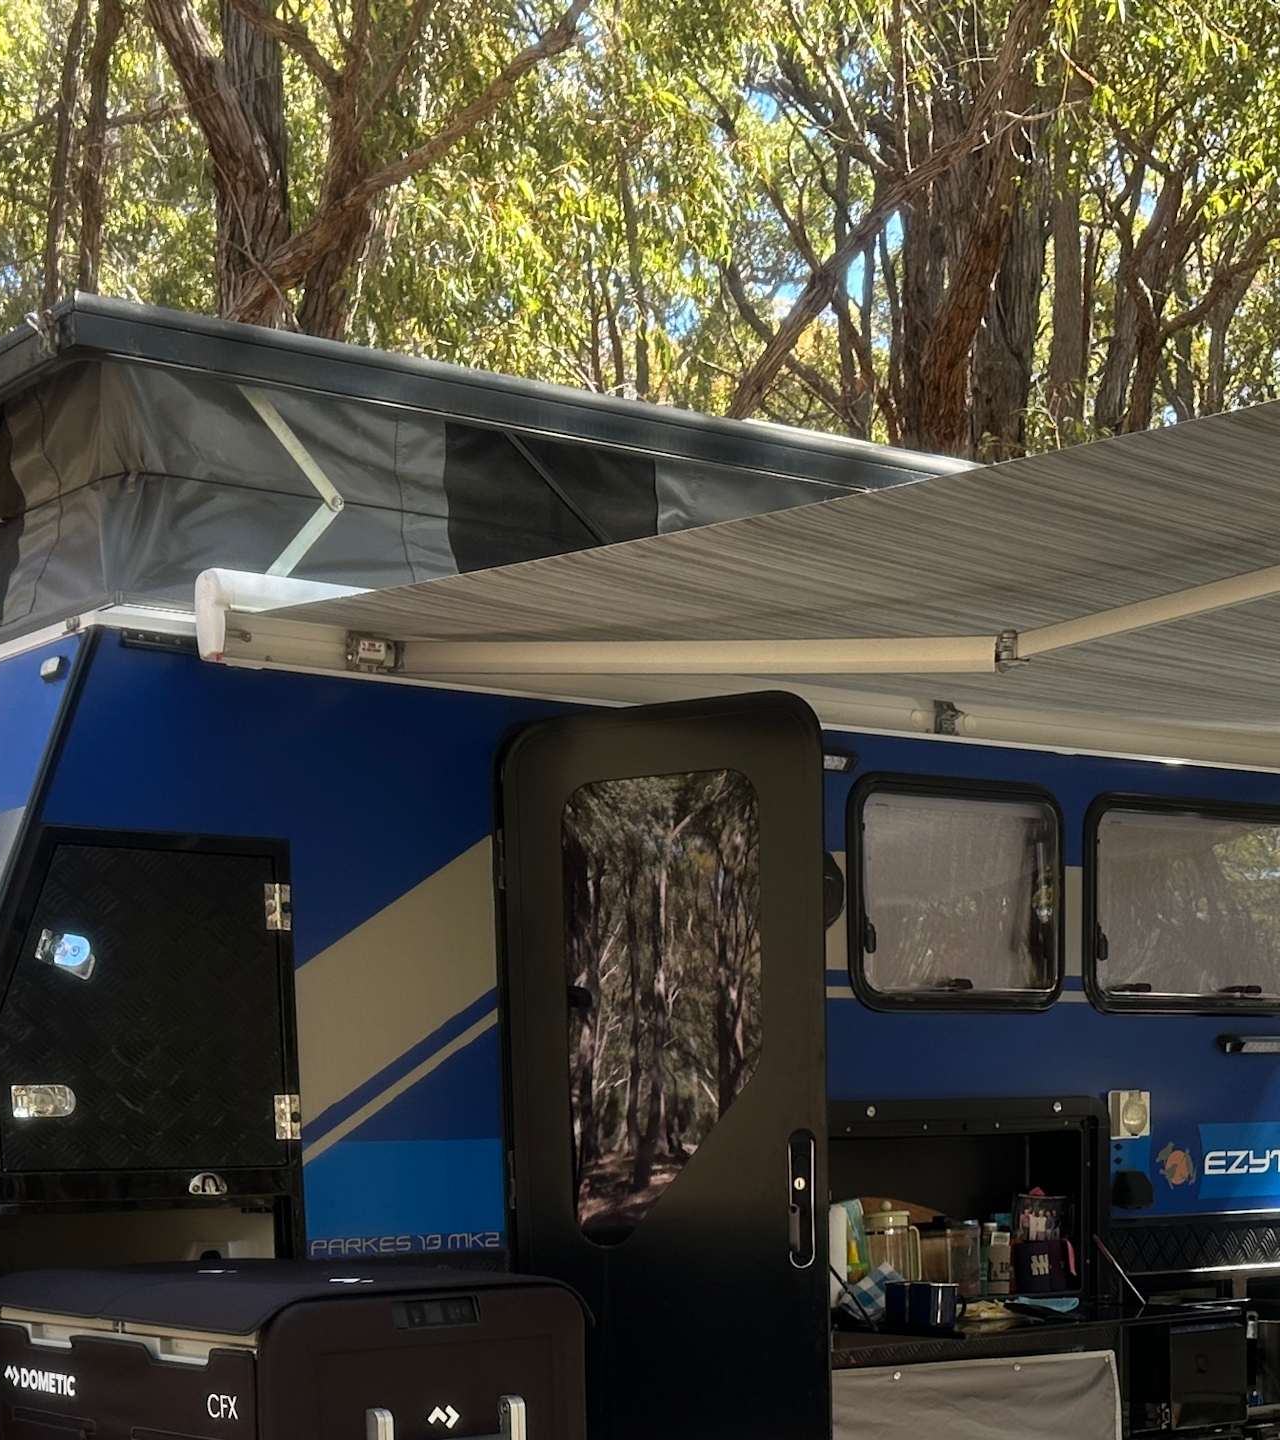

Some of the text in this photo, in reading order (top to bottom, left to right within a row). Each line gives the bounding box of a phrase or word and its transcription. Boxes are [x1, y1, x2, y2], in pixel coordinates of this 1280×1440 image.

[310, 1234, 411, 1257] PARKES
[20, 1367, 76, 1397] DOMETIC
[207, 1393, 239, 1420] CFX
